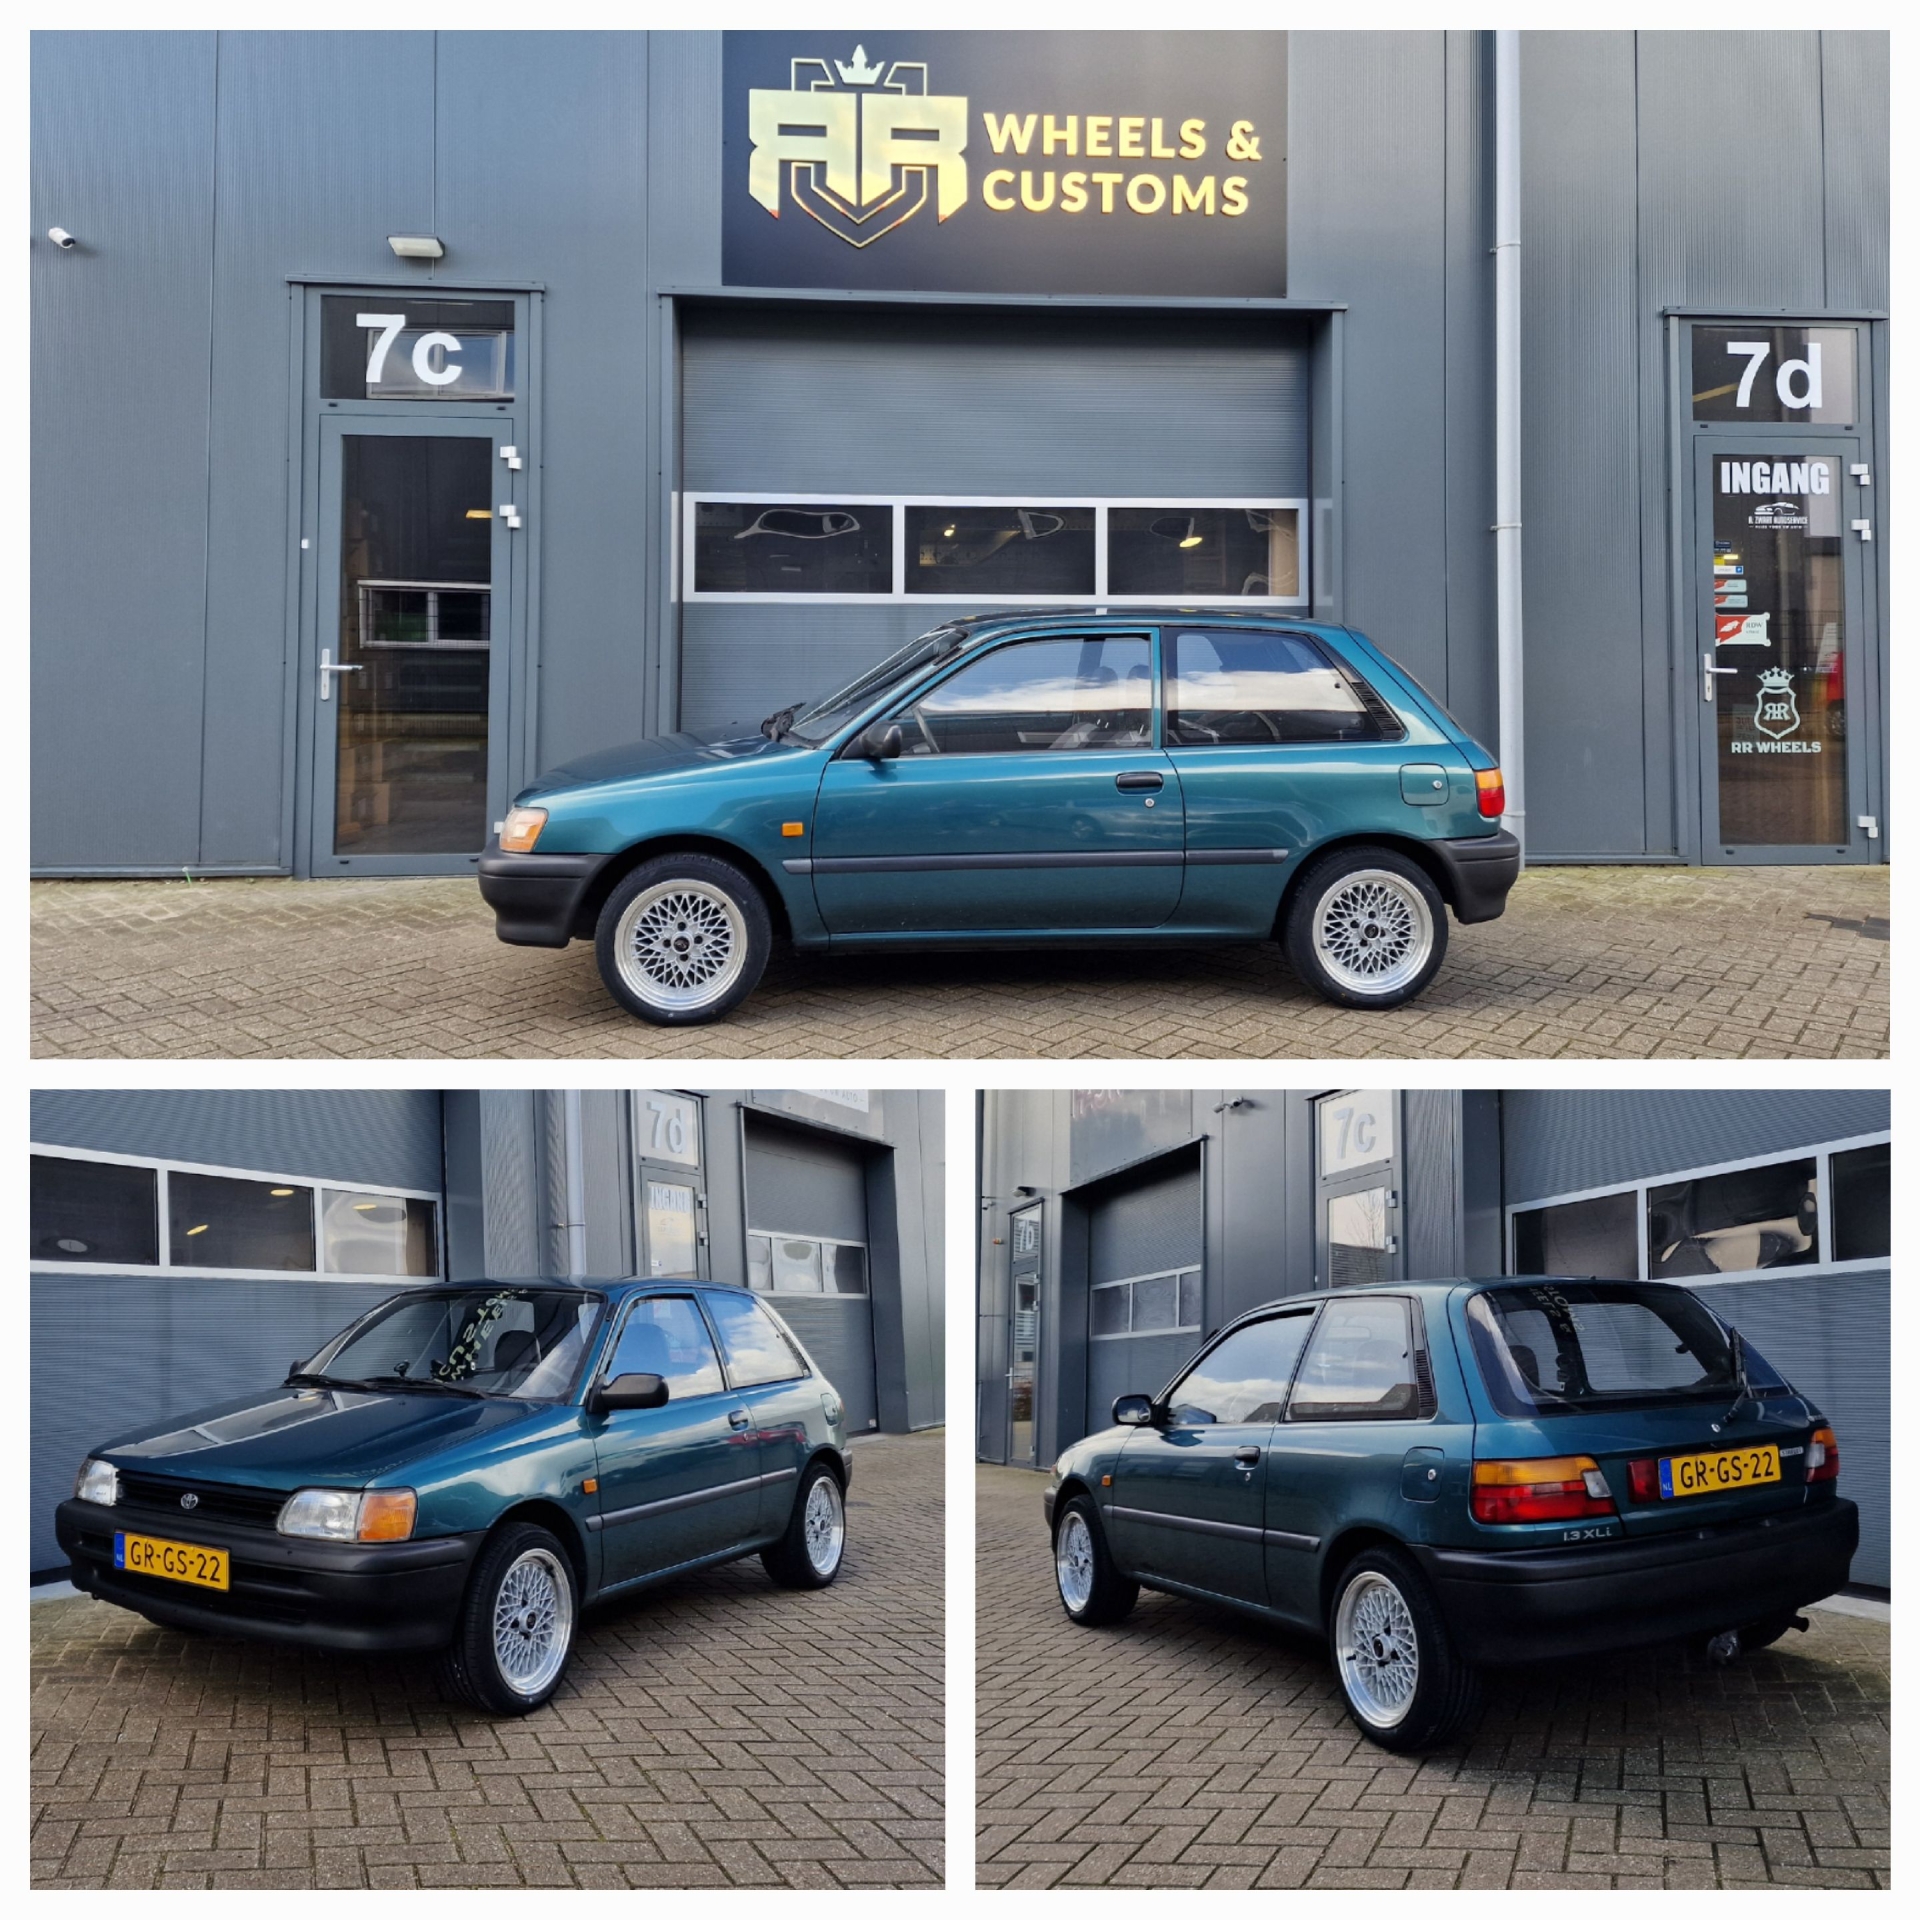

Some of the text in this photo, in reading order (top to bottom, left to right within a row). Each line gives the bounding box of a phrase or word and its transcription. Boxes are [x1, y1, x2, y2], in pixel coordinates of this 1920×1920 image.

[982, 112, 1263, 162] WHEELS &
[982, 169, 1250, 217] CUSTOMS
[356, 313, 463, 386] 7c
[1726, 341, 1823, 409] 7d
[1720, 461, 1830, 495] INGANG
[1731, 741, 1822, 754] RR WHEELS
[647, 1101, 687, 1154] 7d
[1018, 1219, 1035, 1253] 7b
[1662, 1451, 1774, 1491] NL GR-GS-22
[130, 1541, 221, 1583] GR-GS-22
